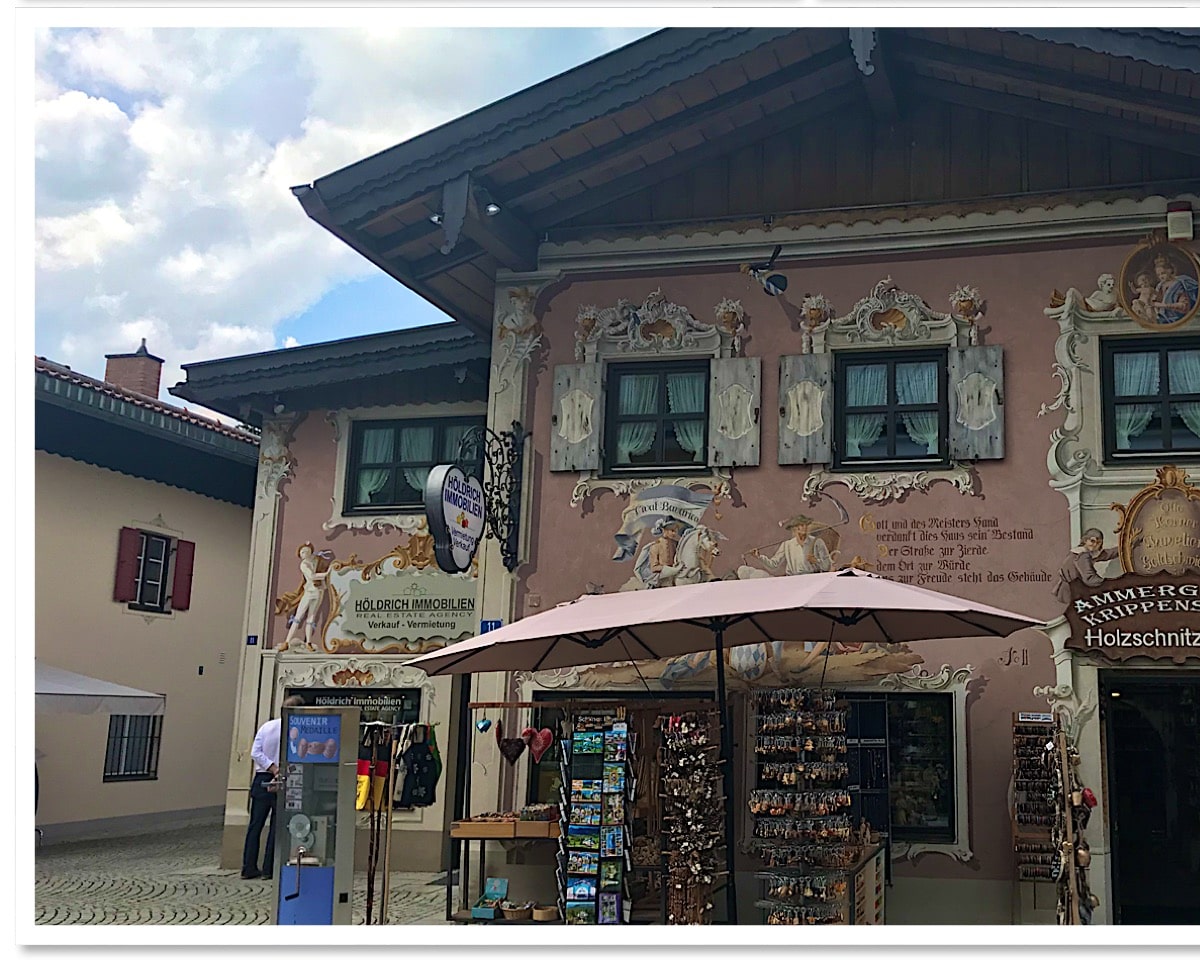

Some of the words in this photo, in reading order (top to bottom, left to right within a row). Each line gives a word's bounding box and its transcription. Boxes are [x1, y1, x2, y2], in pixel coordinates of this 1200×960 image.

[448, 475, 481, 504] HÖLDRICH
[444, 489, 483, 519] IMMOBILIEN
[892, 519, 908, 530] und
[911, 519, 926, 529] des
[928, 517, 971, 529] Meisters
[974, 516, 999, 529] Hand
[451, 526, 475, 546] Vermietung
[920, 531, 938, 541] dies
[941, 530, 965, 542] Haus
[992, 528, 1034, 540] Bestand
[940, 546, 955, 558] zur
[876, 560, 896, 572] dem
[898, 561, 914, 571] Ort
[918, 562, 933, 574] zur
[938, 560, 971, 571] Würde
[917, 572, 952, 586] Freude
[987, 571, 1005, 582] das
[1007, 570, 1053, 583] Gebäude
[355, 597, 409, 611] HÖLDRICH
[412, 598, 475, 610] IMMOBILIEN
[368, 621, 400, 629] Verkauf
[407, 620, 456, 629] Vermietung
[487, 622, 495, 631] 11
[315, 696, 352, 705] Höldrich
[353, 696, 401, 705] Immobilien
[290, 716, 328, 726] SOUVENIR
